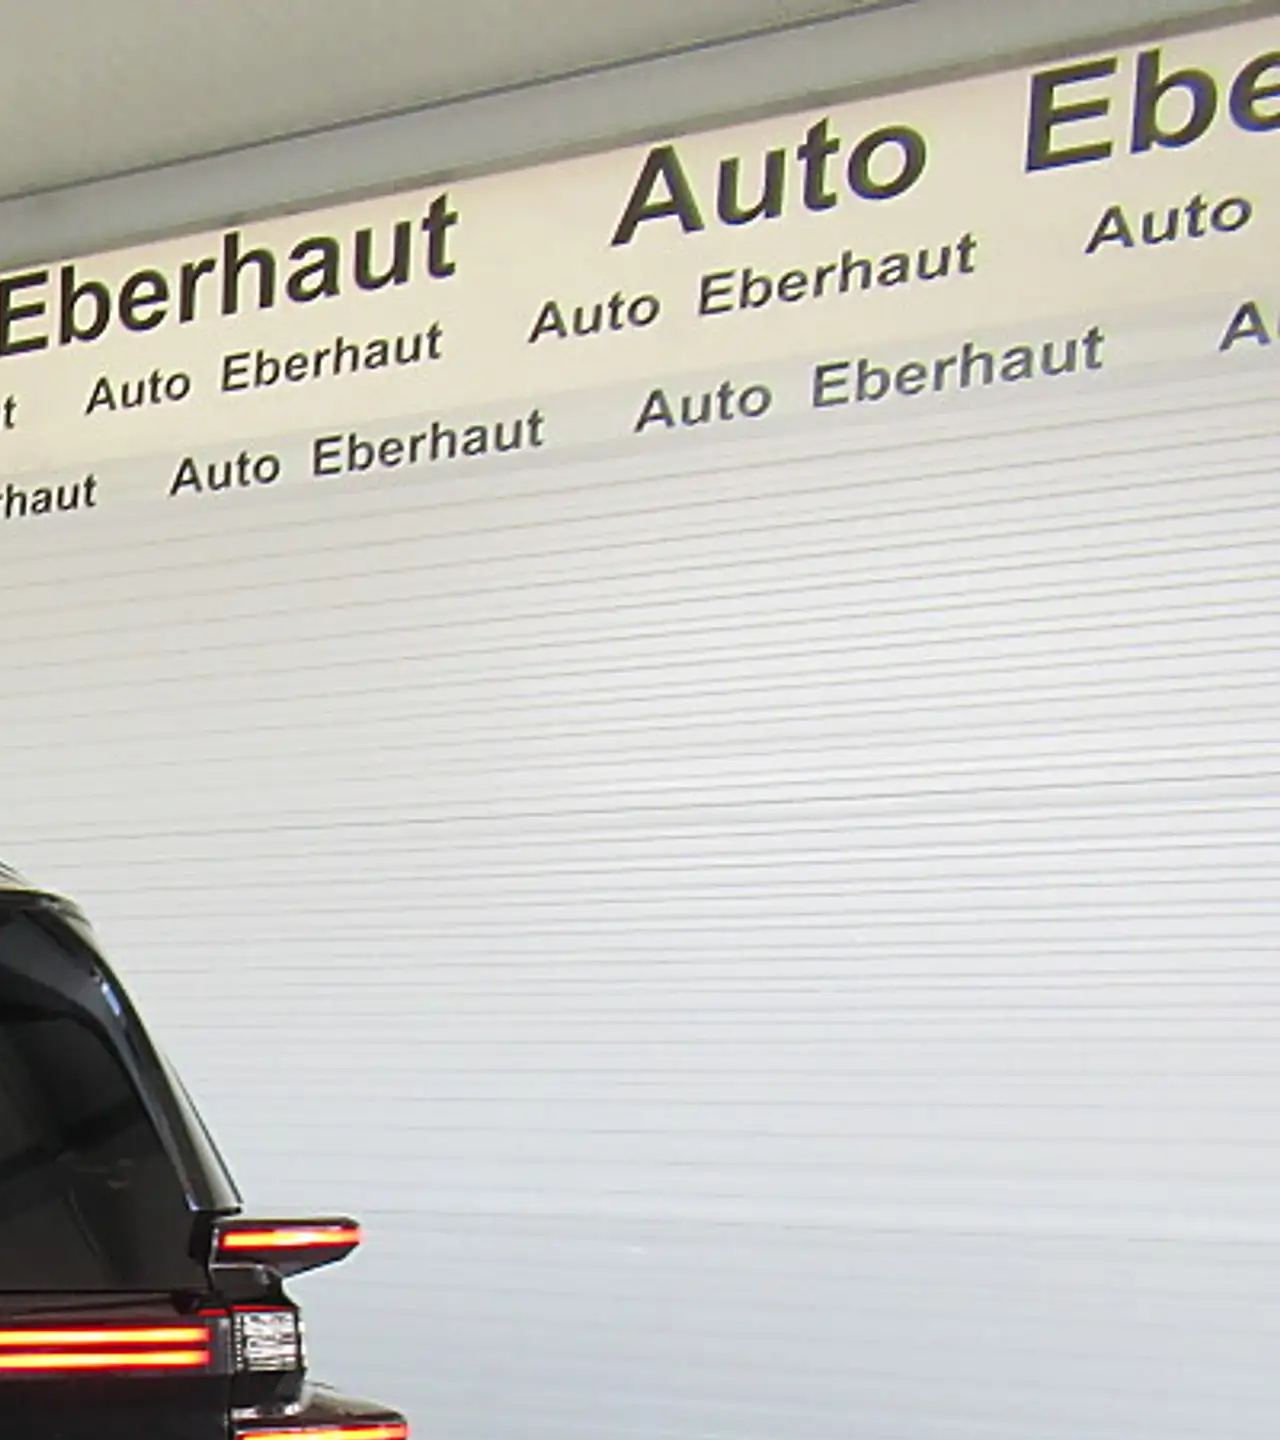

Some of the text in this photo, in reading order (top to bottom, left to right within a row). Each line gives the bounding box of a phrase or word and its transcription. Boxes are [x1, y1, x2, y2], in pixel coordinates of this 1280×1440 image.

[611, 119, 926, 246] Auto
[85, 370, 190, 415] Auto
[221, 322, 442, 392] Eberhaut
[528, 292, 660, 343] Auto
[699, 233, 976, 317] Eberhaut
[1085, 195, 1251, 254] Auto
[170, 450, 280, 496] Auto
[313, 410, 543, 476] Eberhaut
[635, 381, 771, 433] Auto
[813, 327, 1104, 408] Eberhaut
